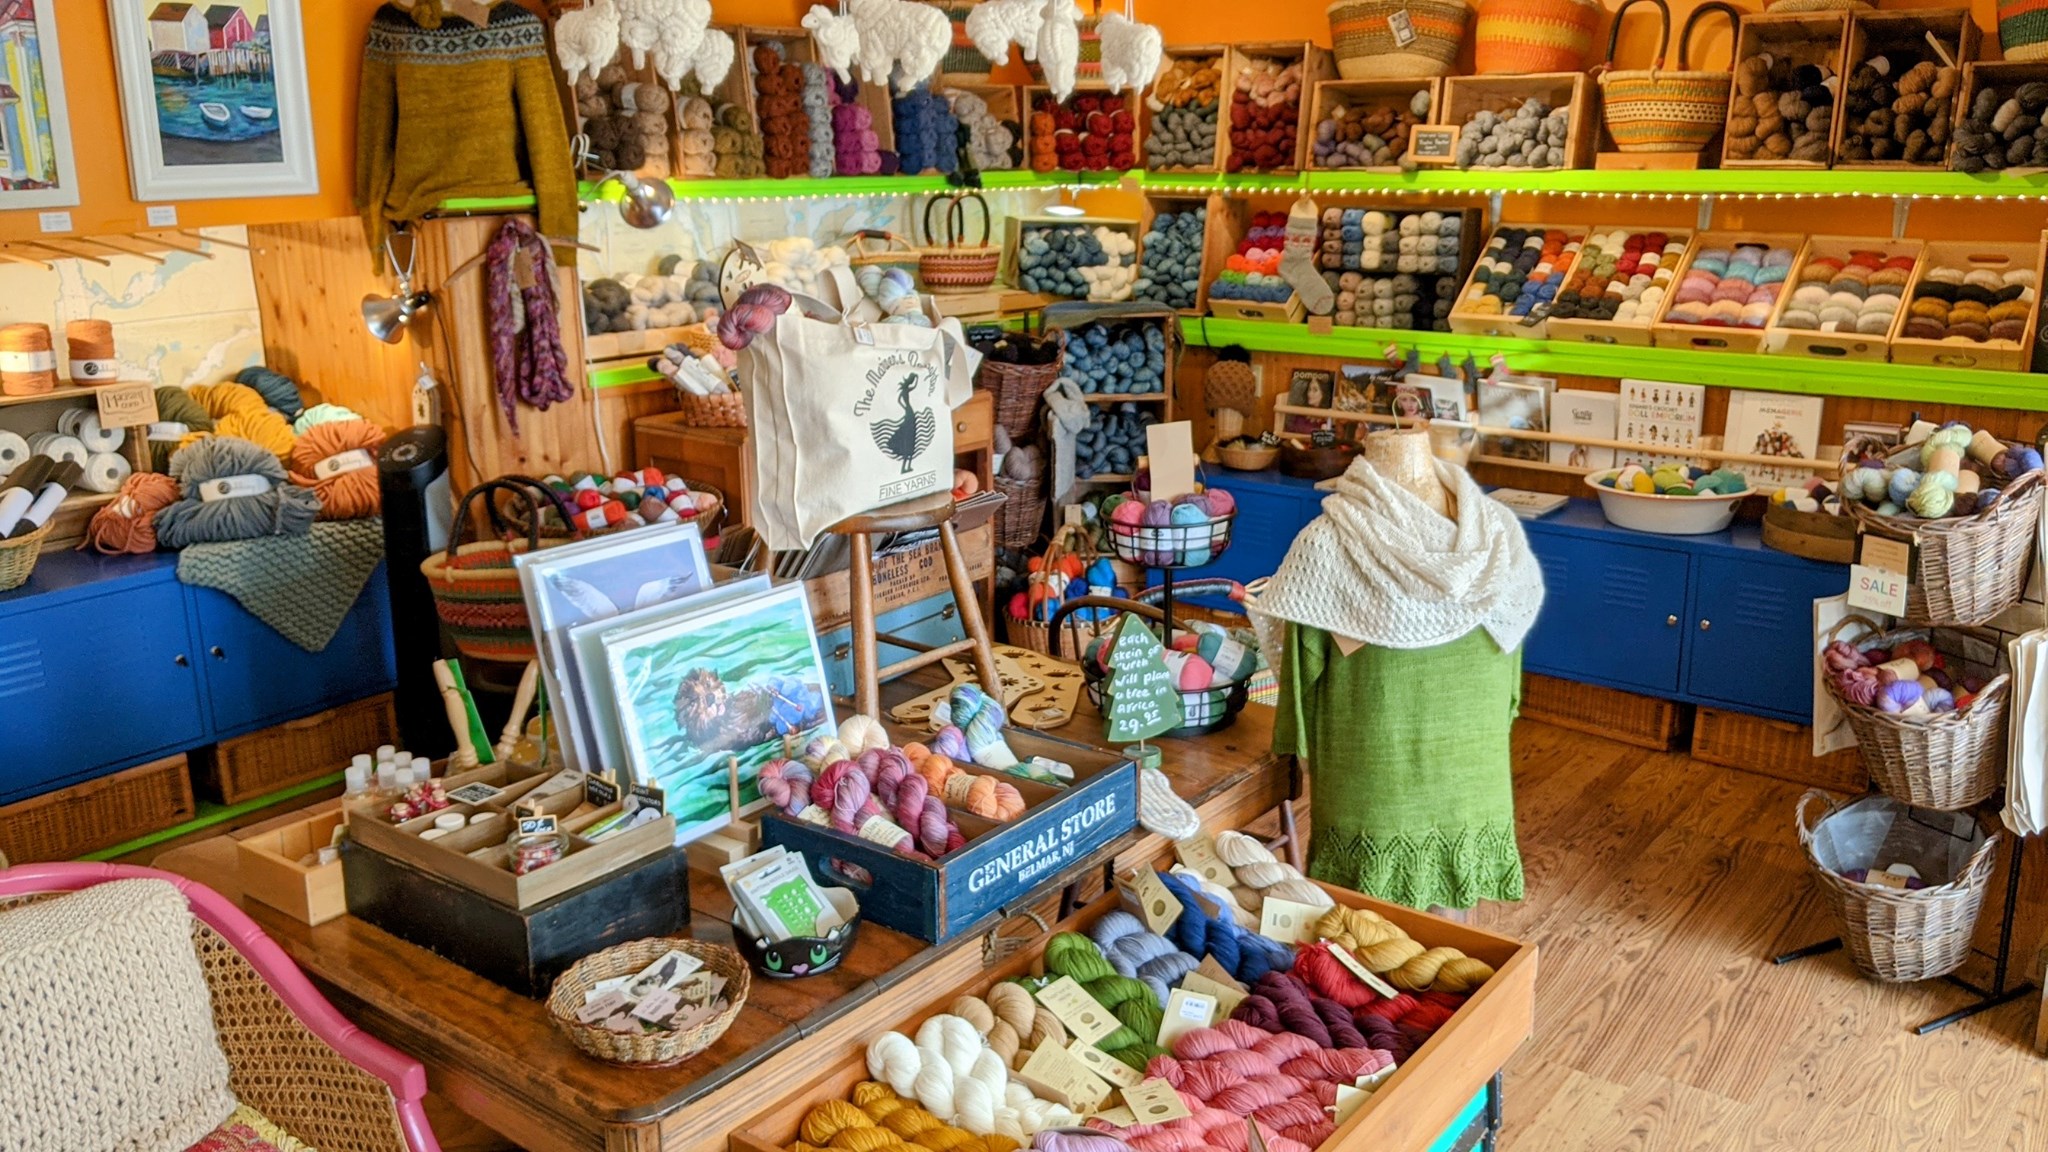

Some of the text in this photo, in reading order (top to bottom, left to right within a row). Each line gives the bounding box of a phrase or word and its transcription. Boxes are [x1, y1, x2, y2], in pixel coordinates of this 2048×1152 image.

[853, 387, 875, 417] The
[879, 473, 937, 499] FINE YARNS
[891, 552, 905, 566] THE
[908, 546, 922, 560] SEA
[918, 556, 934, 570] COD
[1860, 576, 1899, 598] SALE
[1118, 633, 1148, 647] each
[1113, 648, 1143, 661] skein
[1125, 688, 1151, 699] tree
[1155, 686, 1168, 696] in
[968, 827, 1060, 894] GENERAL
[1060, 792, 1117, 842] STORE
[1017, 840, 1076, 883] BELMAR, NJ
